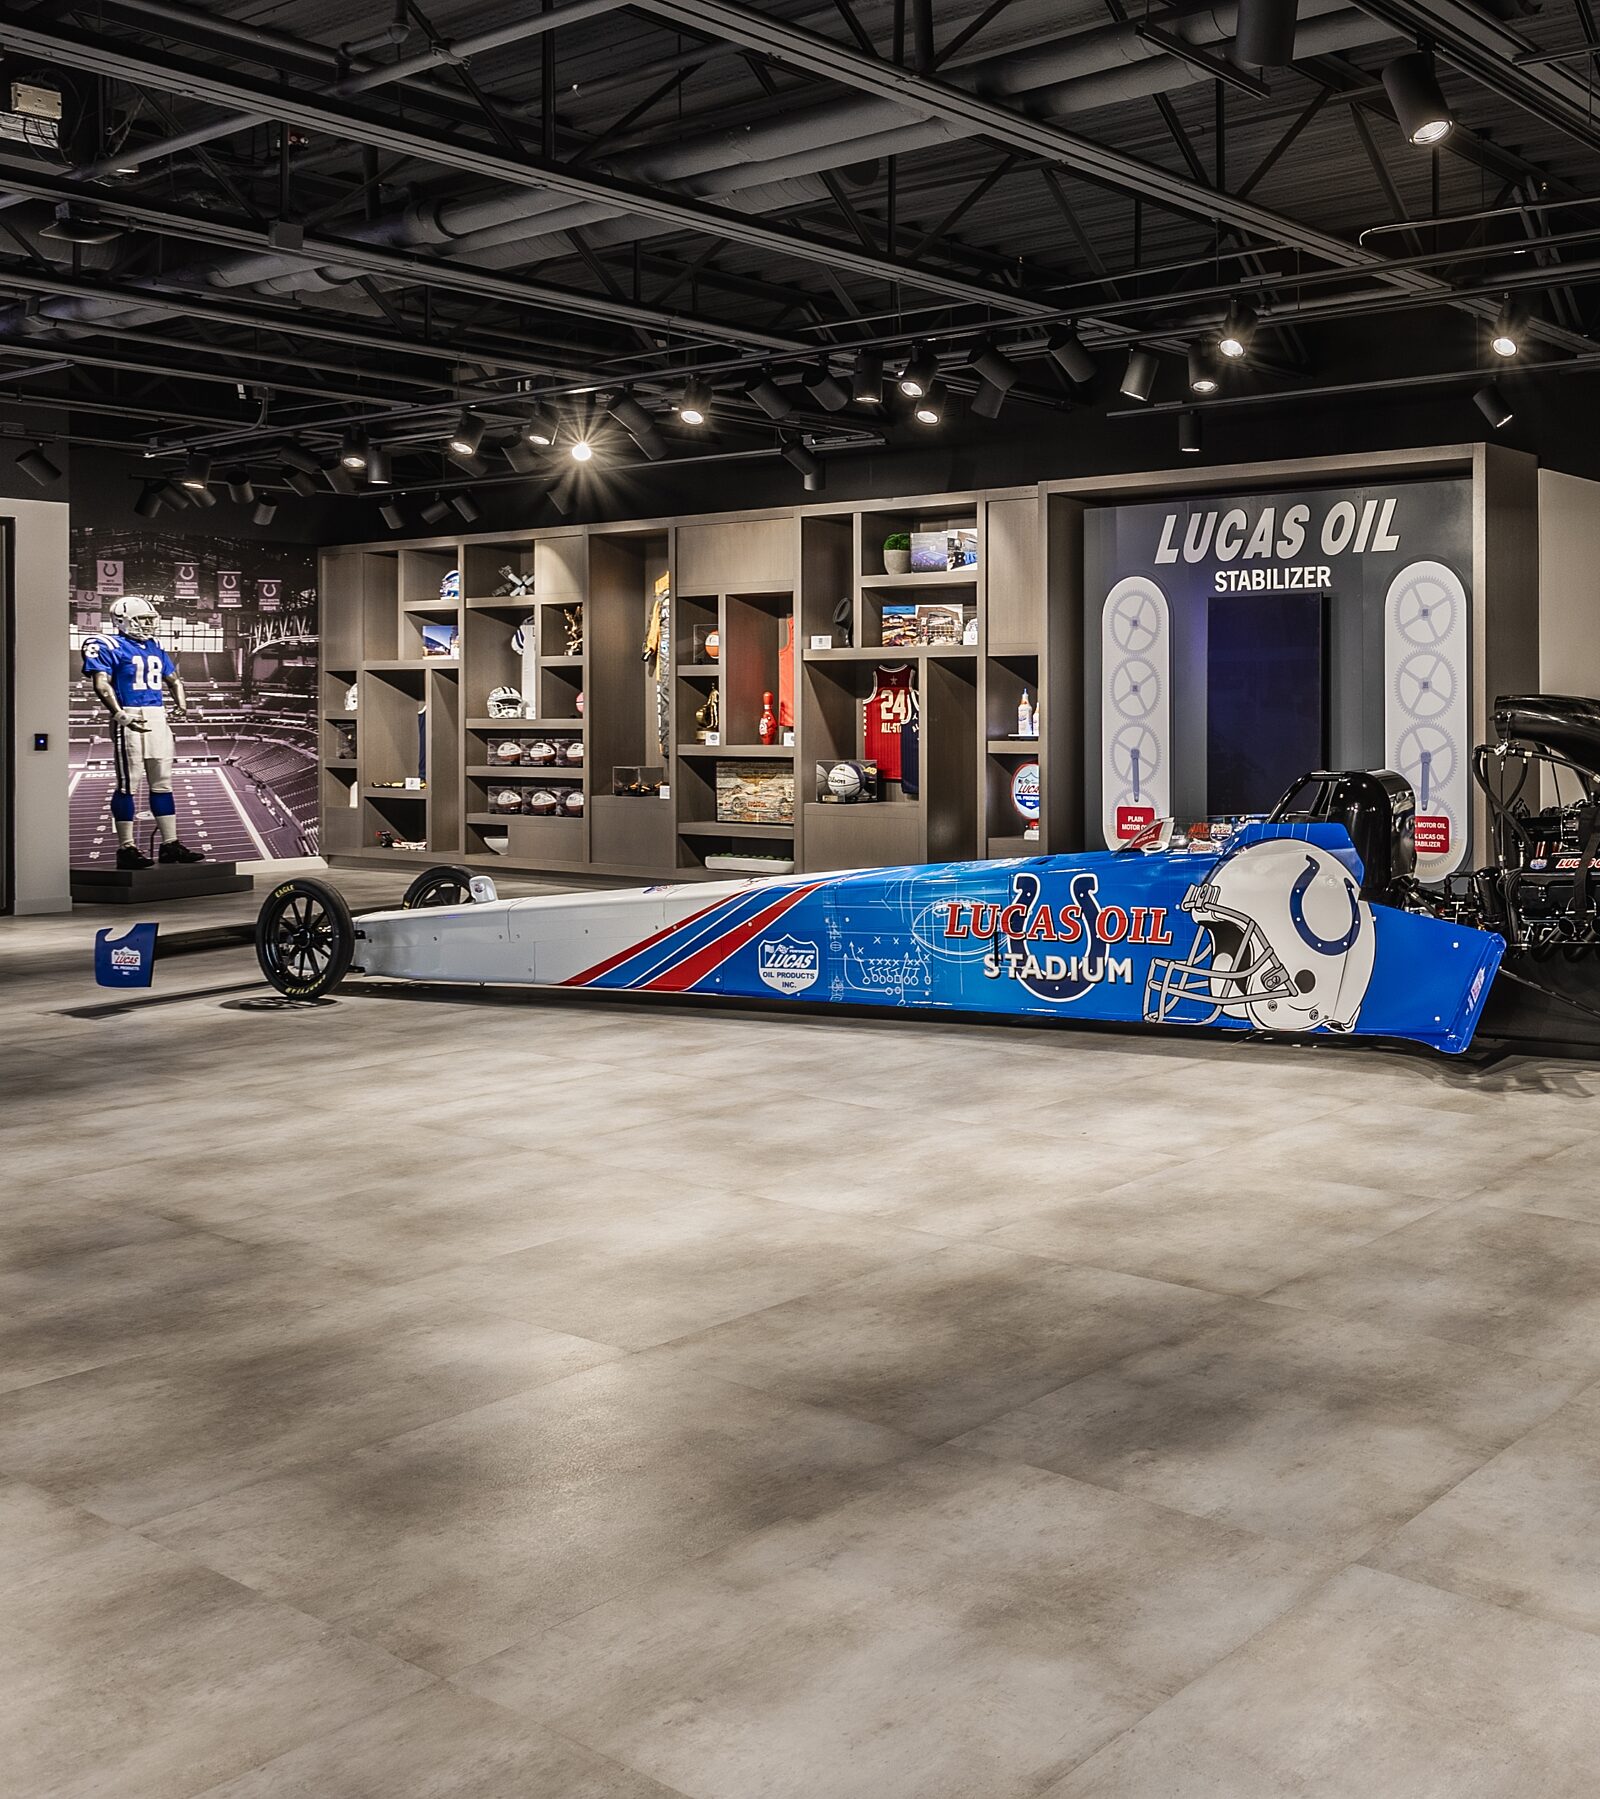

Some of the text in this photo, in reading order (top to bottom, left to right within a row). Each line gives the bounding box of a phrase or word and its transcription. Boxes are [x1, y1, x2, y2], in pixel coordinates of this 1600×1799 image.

[1154, 498, 1400, 565] LUCAS OIL
[1214, 565, 1332, 593] STABILIZER
[132, 655, 163, 690] 18
[880, 689, 907, 720] 24
[881, 722, 902, 733] ALL-ST
[1018, 784, 1040, 793] LUCA
[1127, 815, 1144, 823] PLAIN
[1417, 821, 1437, 829] MOTOR
[1121, 823, 1140, 831] MOTOR
[1414, 840, 1441, 848] TABILIZER
[275, 884, 295, 898] EAGLE
[944, 903, 1173, 945] LUCAS OIL
[765, 954, 815, 968] LUCAS
[983, 953, 1133, 984] STADIUM
